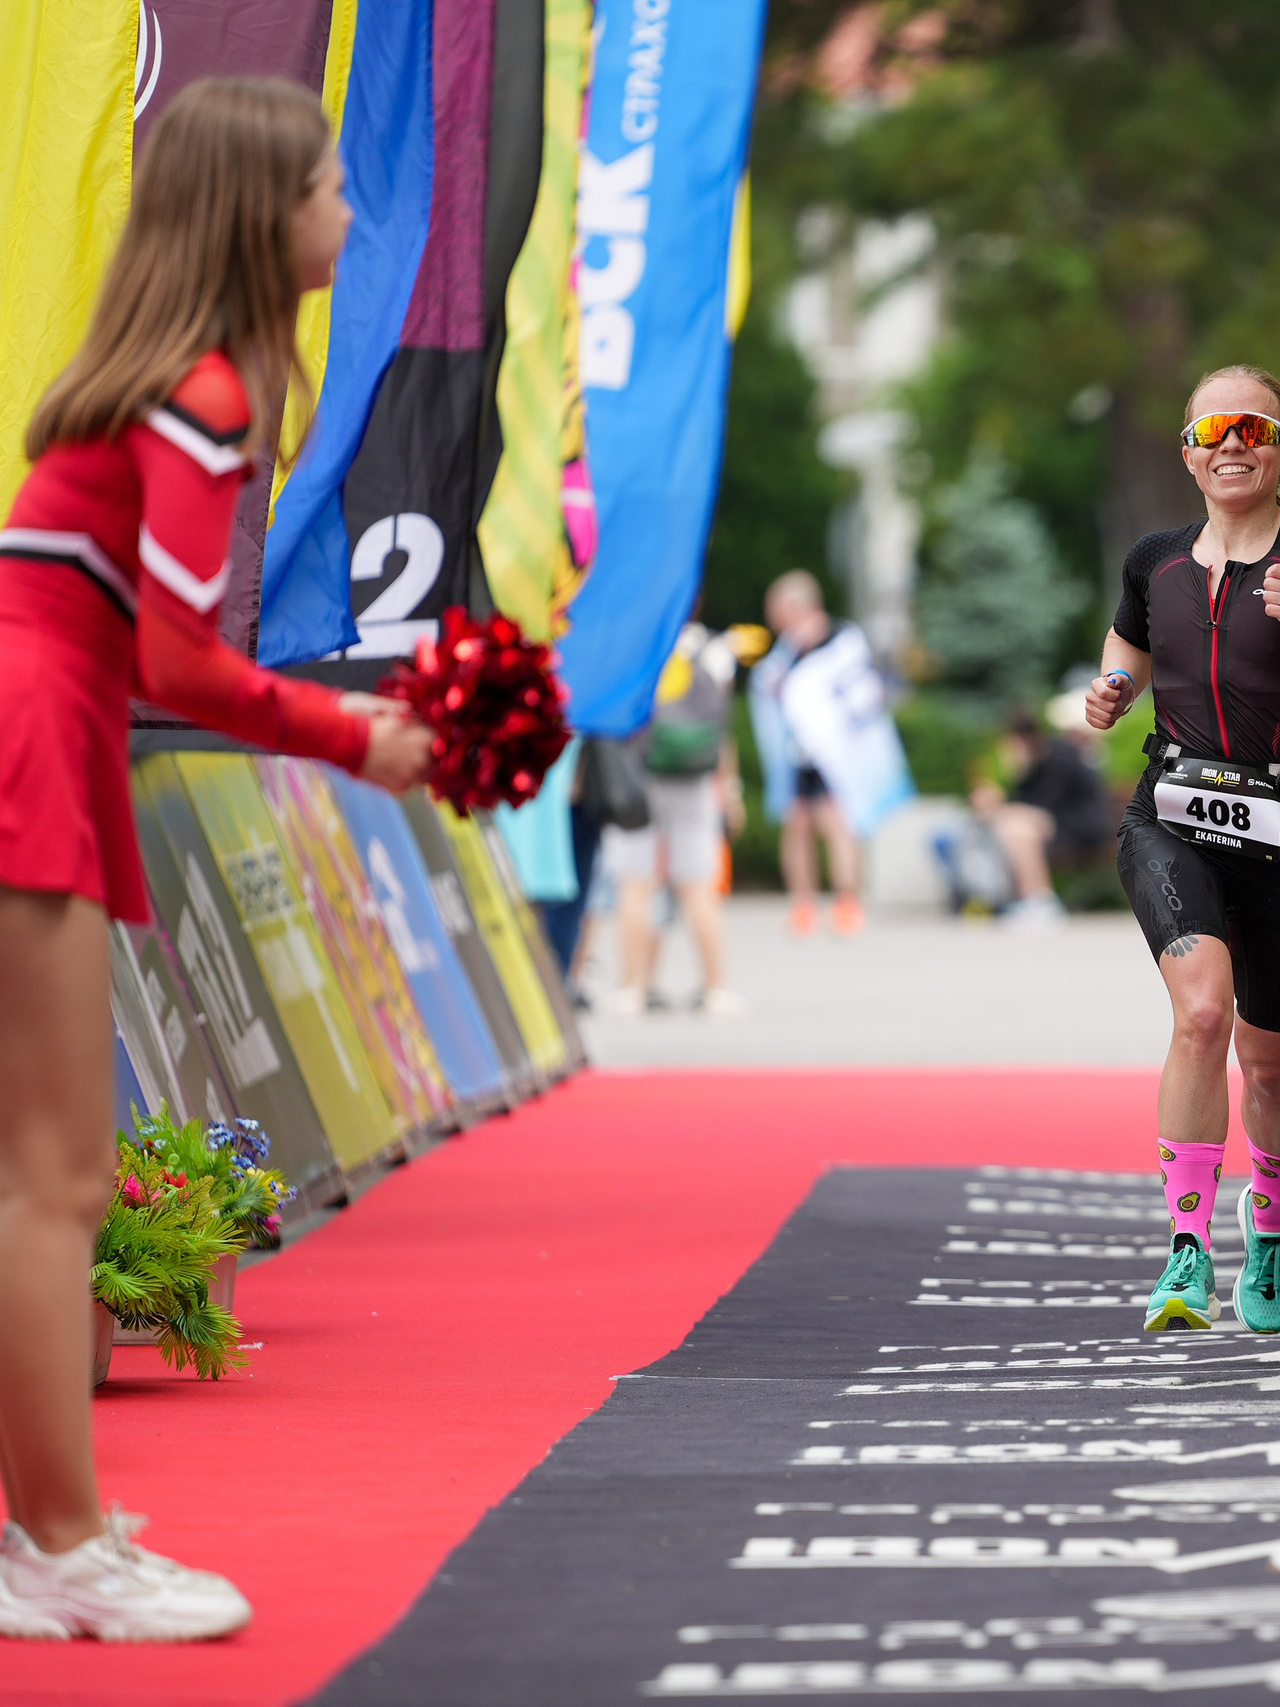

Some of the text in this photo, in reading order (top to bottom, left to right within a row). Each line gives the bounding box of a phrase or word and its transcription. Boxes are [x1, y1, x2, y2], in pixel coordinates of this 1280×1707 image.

[1201, 767, 1218, 778] IRON
[1223, 770, 1241, 782] STAR
[1186, 797, 1251, 831] 408
[1195, 830, 1242, 849] EKATERINA
[1147, 859, 1183, 911] orca
[842, 1376, 1184, 1393] IRON
[803, 1438, 1183, 1461] IRON
[743, 1536, 1179, 1560] IRON
[659, 1659, 1167, 1691] IRON
